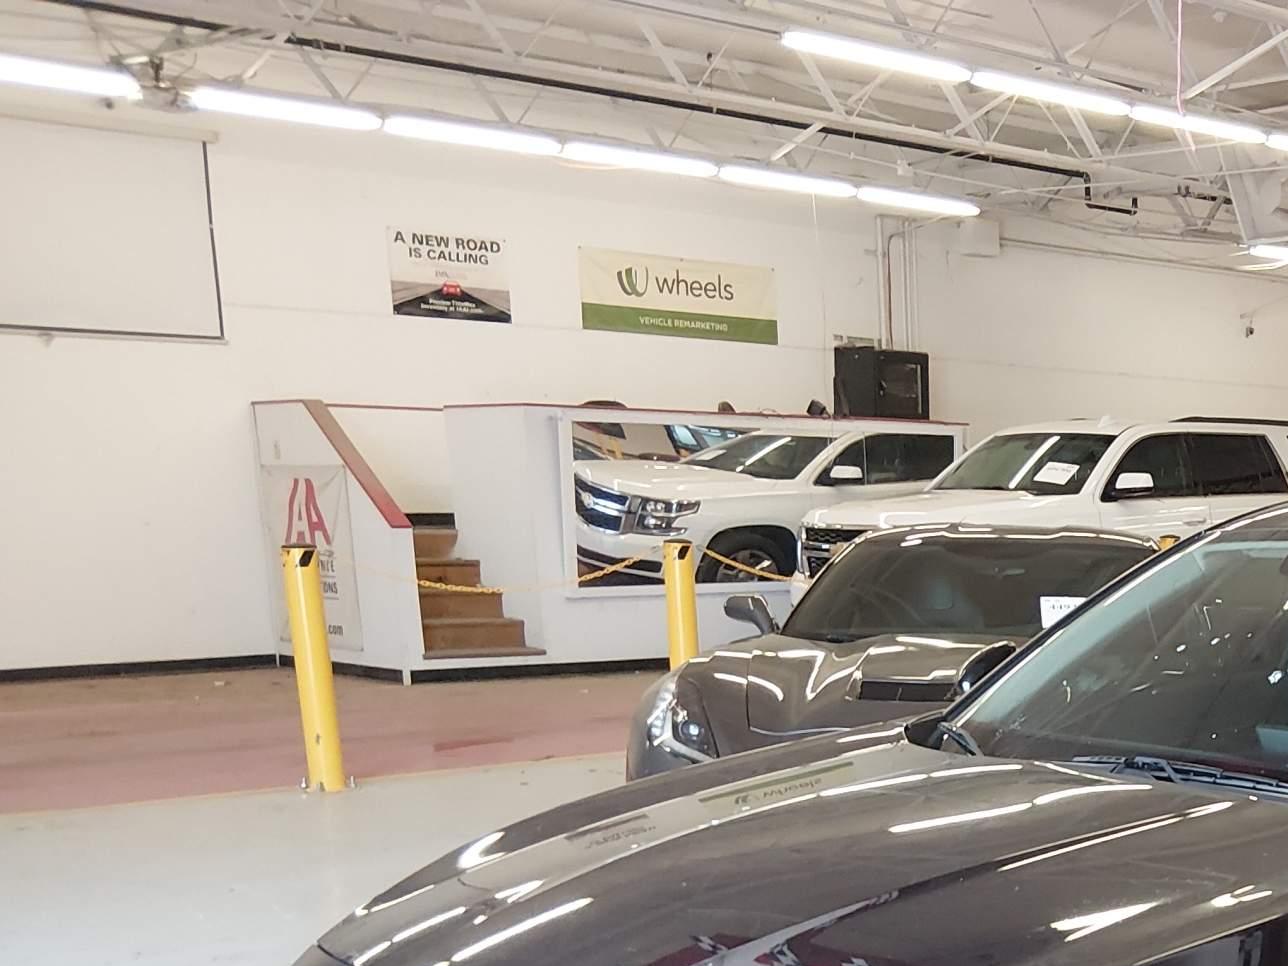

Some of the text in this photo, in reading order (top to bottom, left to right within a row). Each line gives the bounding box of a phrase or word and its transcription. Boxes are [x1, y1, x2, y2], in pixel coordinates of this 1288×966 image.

[394, 231, 501, 253] A NEW ROAD
[408, 247, 489, 265] IS CALLING
[655, 269, 734, 301] wheels
[639, 316, 729, 332] VEHICLE REMARKETING
